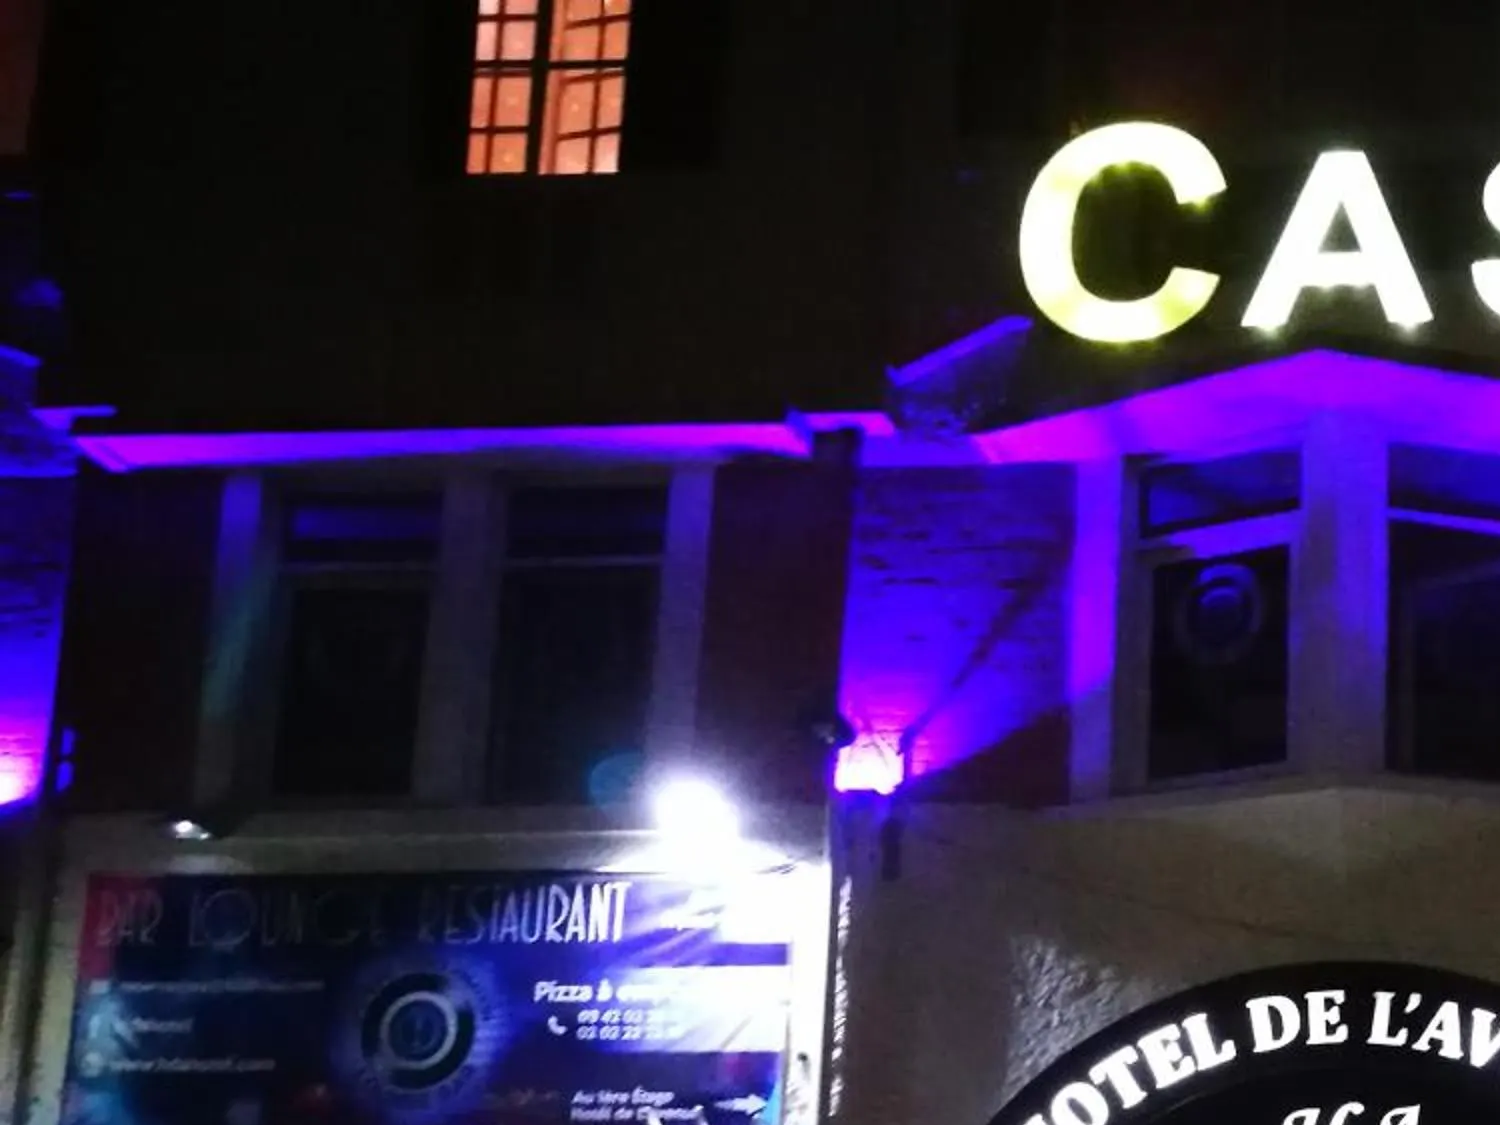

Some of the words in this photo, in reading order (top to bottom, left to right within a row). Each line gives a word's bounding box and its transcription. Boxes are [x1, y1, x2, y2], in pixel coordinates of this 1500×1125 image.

[418, 881, 632, 944] RESTAURANT
[533, 980, 594, 1003] Pizza
[1245, 989, 1349, 1053] DE
